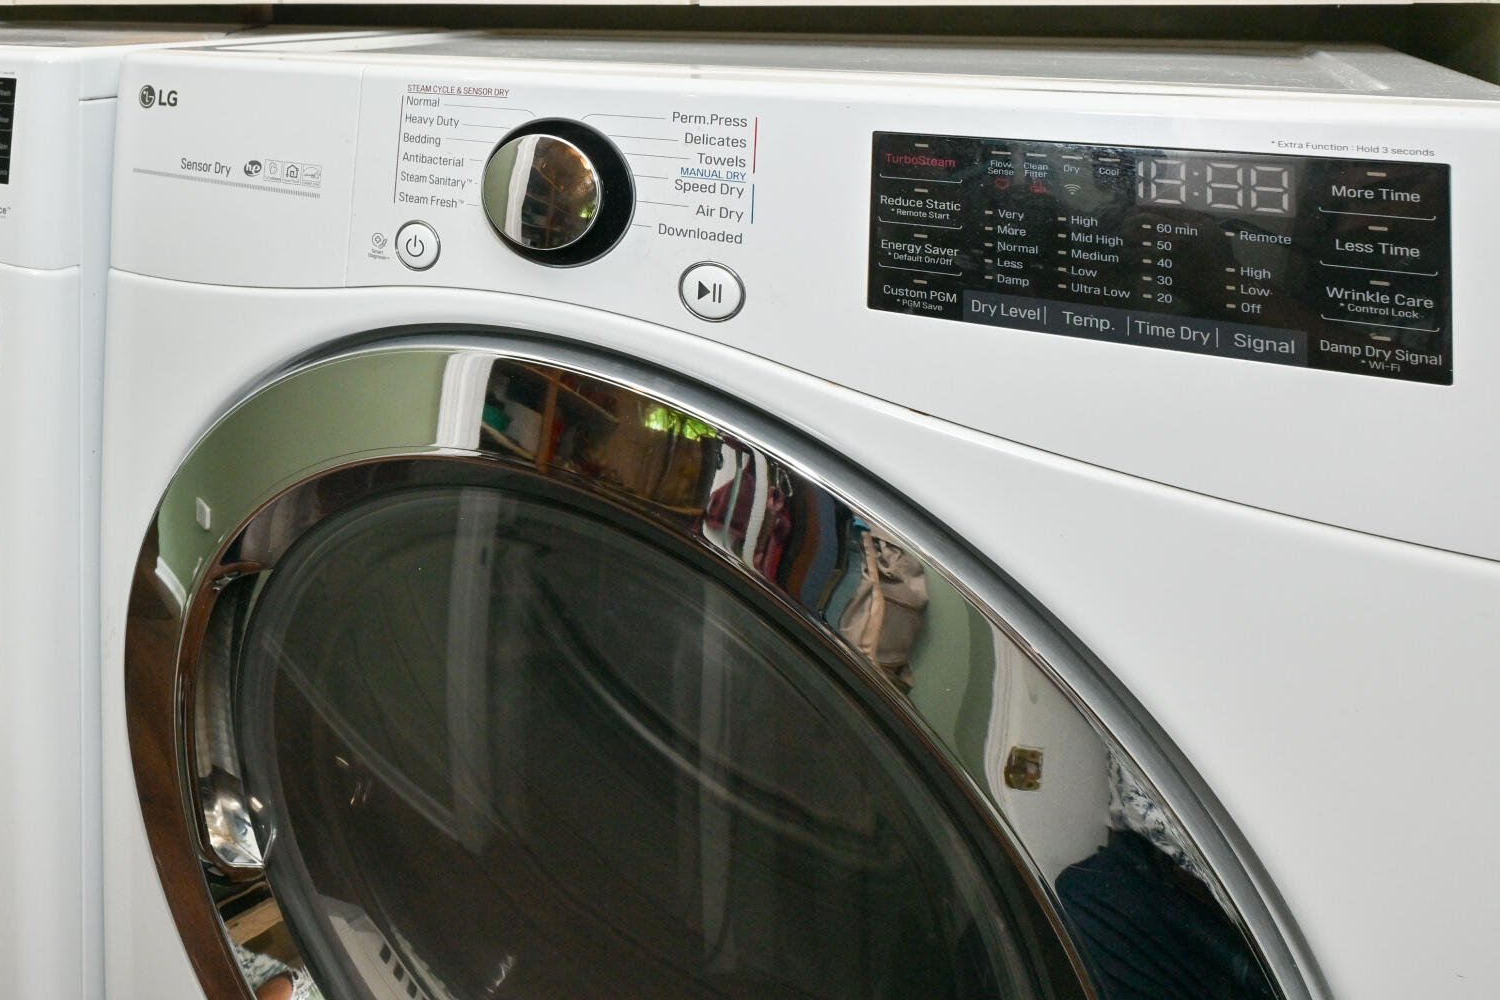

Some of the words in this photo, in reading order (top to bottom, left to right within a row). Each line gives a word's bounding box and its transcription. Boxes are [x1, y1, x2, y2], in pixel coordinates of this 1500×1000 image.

[407, 84, 432, 93] STEAM
[432, 85, 455, 94] CYCLE
[463, 86, 493, 96] SENSOR
[494, 88, 510, 97] DRY
[406, 95, 440, 107] Normal
[405, 113, 435, 126] Heavy
[436, 115, 460, 129] Duty
[403, 132, 442, 148] Bedding
[684, 132, 747, 149] Delicates
[1277, 140, 1304, 149] Extra
[1305, 142, 1349, 152] Function
[1356, 145, 1380, 154] Hold
[1382, 146, 1389, 154] 3
[1390, 147, 1435, 157] seconds
[402, 151, 464, 167] Antibacterial
[697, 152, 747, 168] Towels
[885, 153, 957, 168] TurboSteam
[990, 159, 1010, 168] Flow
[1023, 161, 1049, 171] Clean
[181, 157, 212, 172] Sensor
[214, 161, 232, 178] Dry
[680, 167, 724, 179] MANUAL
[726, 170, 747, 181] DRY
[987, 167, 1014, 176] Sense
[1024, 169, 1048, 178] Filter
[1063, 164, 1080, 174] Dry
[1098, 167, 1120, 176] Cool
[400, 171, 427, 184] Steam
[674, 179, 717, 194] Speed
[720, 183, 745, 199] Dry
[1331, 184, 1375, 199] More
[1377, 187, 1421, 203] Time
[398, 192, 429, 205] Steam
[880, 194, 923, 208] Reduce
[926, 198, 961, 212] Static
[695, 204, 716, 217] Air
[719, 206, 744, 223] Dry
[896, 208, 928, 218] Remote
[928, 211, 950, 220] Start
[997, 209, 1025, 221] Very
[1071, 215, 1099, 228] High
[658, 223, 743, 245] Downloaded
[997, 224, 1027, 237] More
[1156, 223, 1172, 234] 60
[1175, 225, 1198, 236] min
[1071, 232, 1093, 243] Mid
[1095, 234, 1124, 248] High
[1239, 230, 1292, 245] Remote
[881, 239, 922, 254] Energy
[924, 243, 960, 257] Saver
[997, 241, 1039, 255] Normal
[1156, 241, 1172, 251] 50
[1335, 238, 1374, 254] Less
[1377, 242, 1421, 258] Time
[893, 252, 922, 263] Default
[924, 256, 953, 266] On/Off
[1071, 249, 1120, 263] Medium
[997, 257, 1024, 270] Less
[1156, 258, 1173, 269] 40
[1071, 265, 1098, 278] Low
[1240, 266, 1272, 280] High
[997, 273, 1030, 288] Damp
[1156, 275, 1173, 286] 30
[883, 284, 927, 299] Custom
[930, 290, 957, 303] PGM
[1071, 282, 1101, 295] Ultra
[1103, 286, 1131, 298] Low
[1240, 284, 1270, 297] Low
[1326, 285, 1390, 304] Wrinkle
[1394, 293, 1435, 309] Care
[902, 298, 921, 308] PGM
[922, 301, 943, 311] Save
[1157, 293, 1173, 304] 20
[971, 299, 997, 318] Dry
[1000, 303, 1041, 321] Level
[1240, 302, 1262, 314] Off
[1347, 303, 1389, 316] Control
[1391, 307, 1420, 319] Lock
[1061, 310, 1116, 332] Temp.
[1134, 320, 1176, 339] Time
[1180, 326, 1211, 345] Dry
[1233, 332, 1295, 355] Signal
[1320, 339, 1362, 358] Damp
[1365, 345, 1392, 361] Dry
[1395, 349, 1443, 366] Signal
[1368, 359, 1401, 372] Wi-Fi
